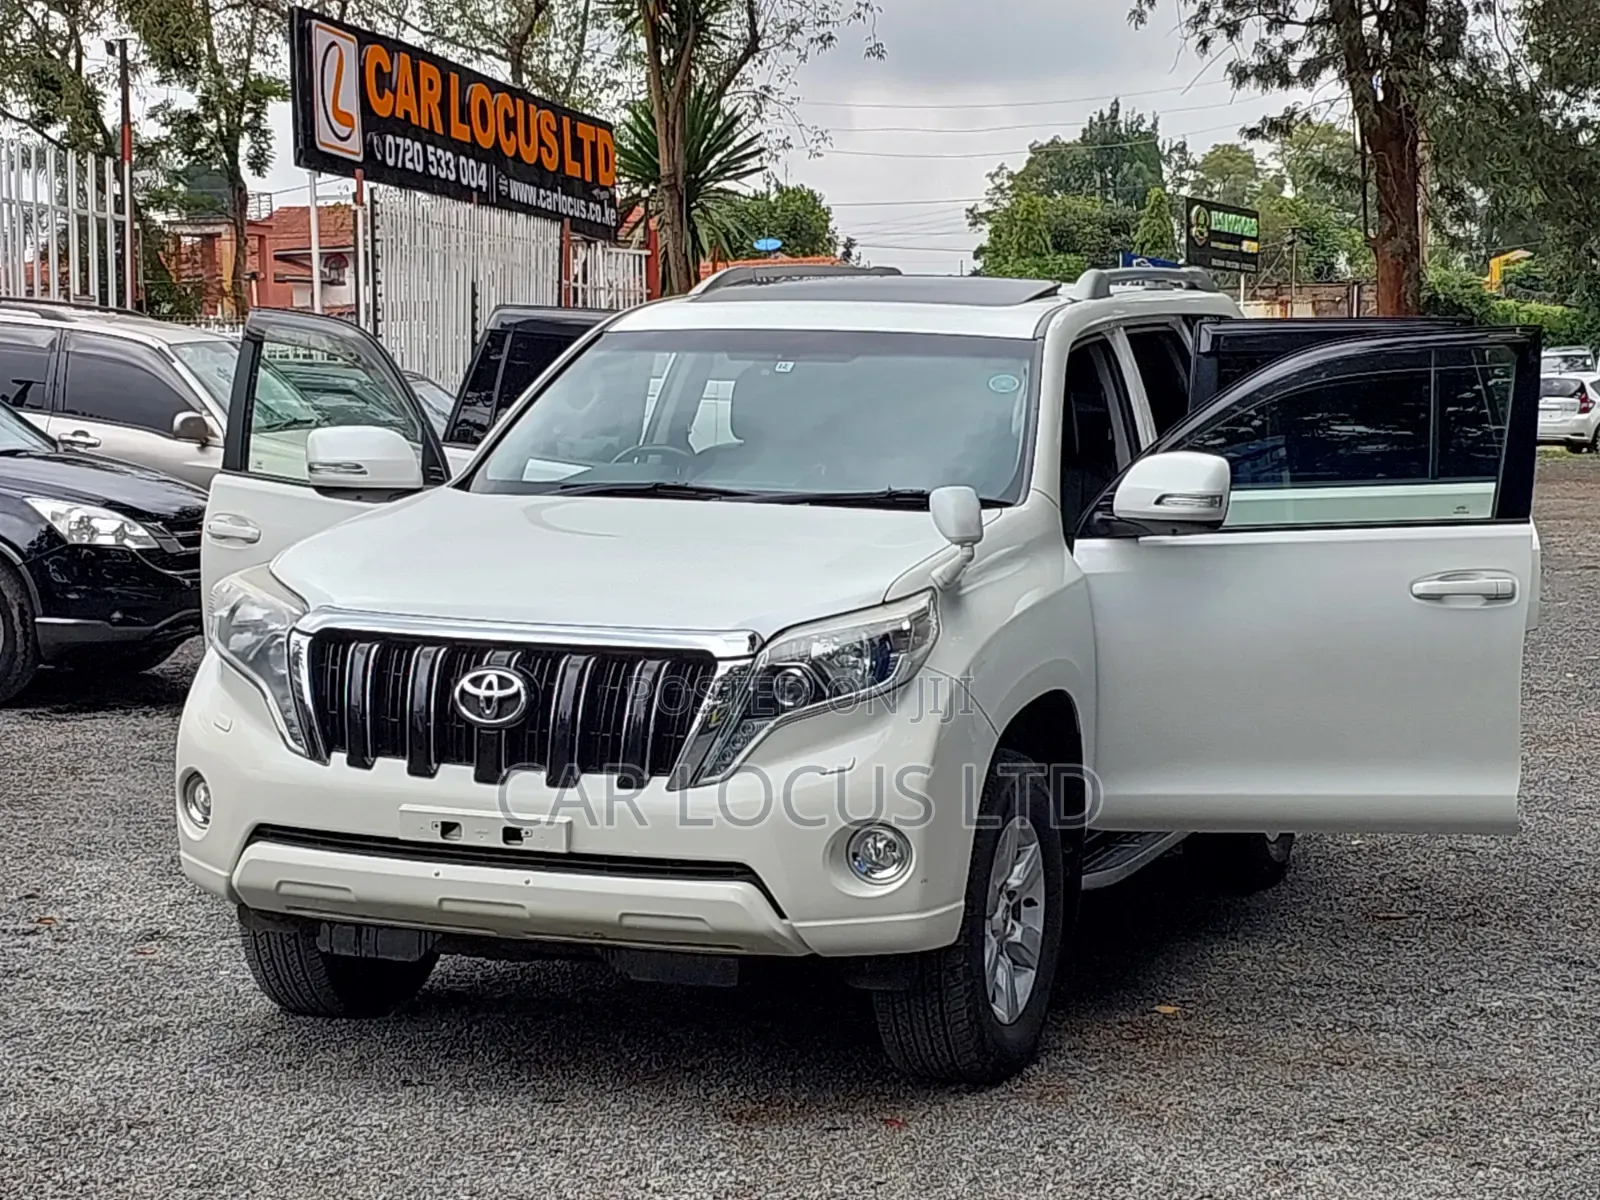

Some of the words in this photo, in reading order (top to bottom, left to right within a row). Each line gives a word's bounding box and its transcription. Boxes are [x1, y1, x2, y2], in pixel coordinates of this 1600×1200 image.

[364, 44, 443, 135] CAR
[450, 72, 559, 172] LOCUS
[562, 116, 615, 187] LTD
[385, 134, 423, 173] 0720
[427, 146, 456, 181] 533
[459, 158, 488, 192] 004
[509, 179, 616, 227] www.carlocus.co.ke
